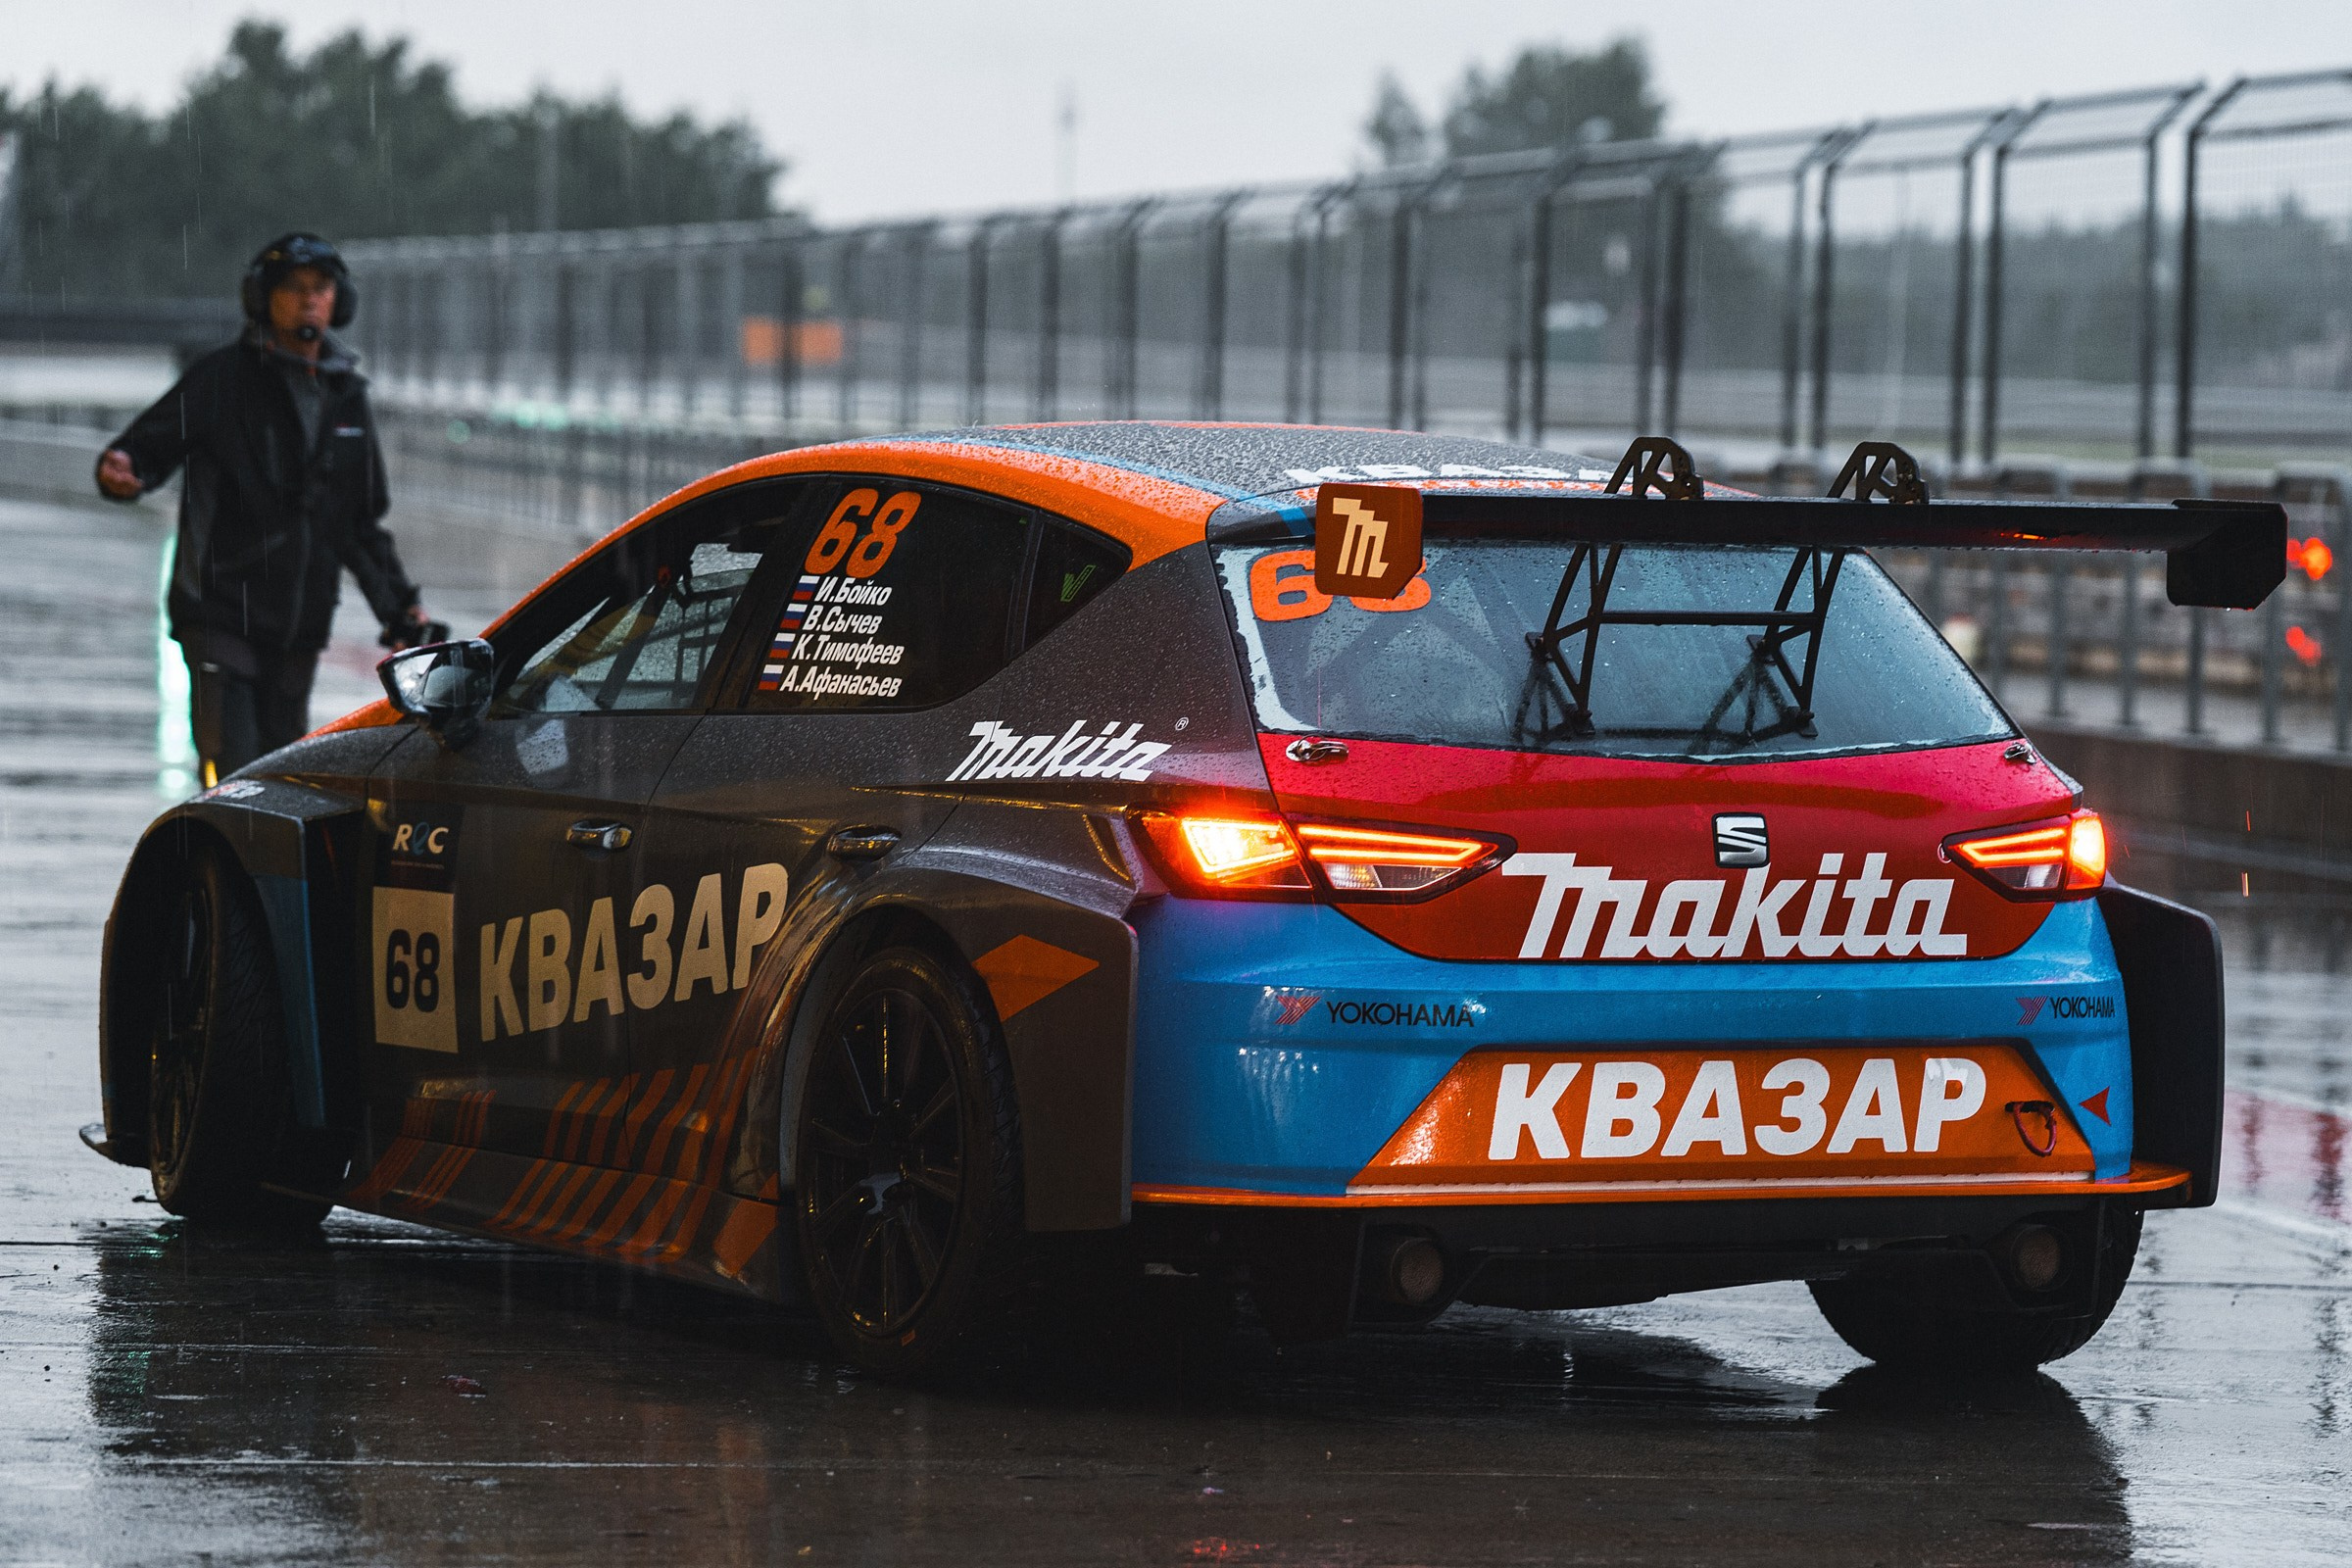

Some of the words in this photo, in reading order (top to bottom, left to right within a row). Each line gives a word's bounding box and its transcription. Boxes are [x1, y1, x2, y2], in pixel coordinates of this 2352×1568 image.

[804, 488, 922, 578] 68
[813, 576, 893, 606] И.Бойко
[802, 605, 883, 635] В.Сычев
[791, 634, 905, 670] К.Тимофеев
[779, 665, 903, 701] А.Афанасьев
[480, 862, 789, 1042] КВАЗАР
[386, 929, 441, 1013] 68
[1326, 1002, 1475, 1028] YOKOHAMA
[2050, 996, 2116, 1019] YOKOHAMA
[1488, 1057, 1986, 1160] КВАЗАР
